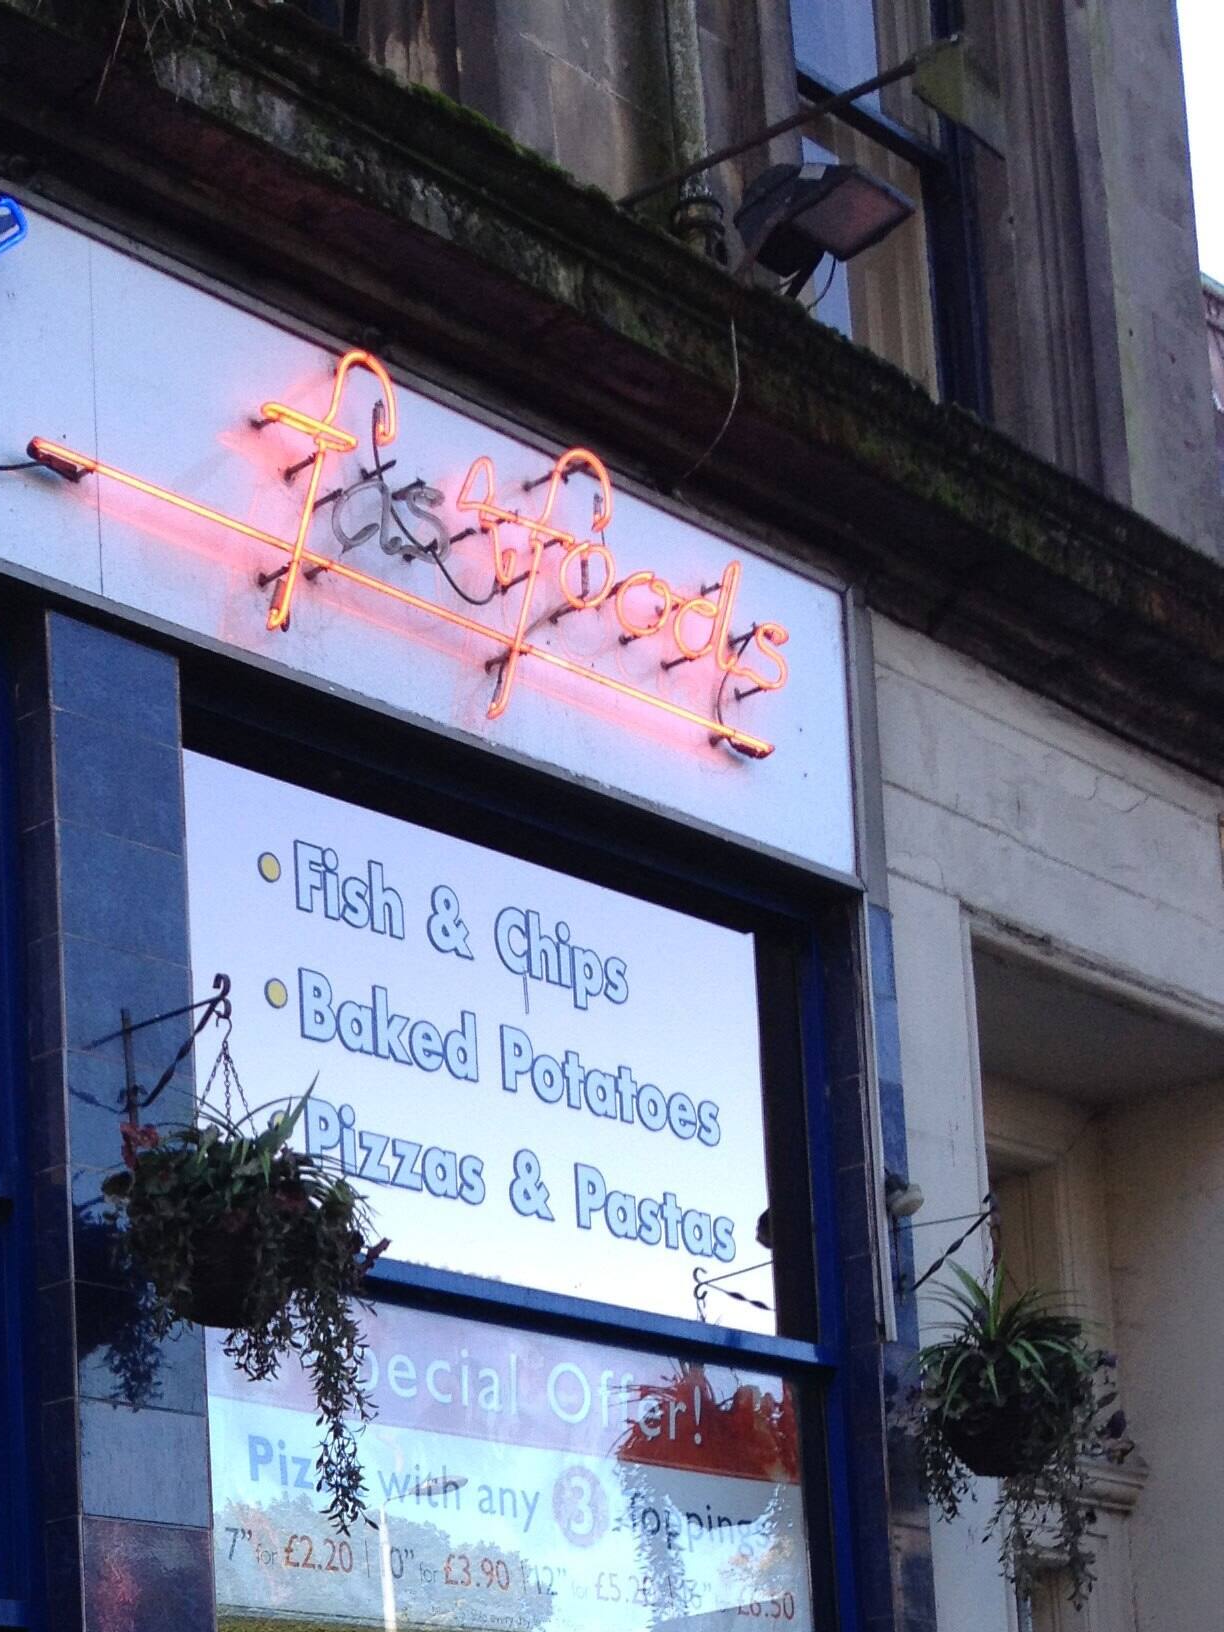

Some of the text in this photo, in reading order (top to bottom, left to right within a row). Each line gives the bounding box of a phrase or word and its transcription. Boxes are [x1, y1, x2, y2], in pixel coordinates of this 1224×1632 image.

[293, 839, 629, 1010] Fish & Chips
[298, 967, 722, 1147] Baked Potatoes
[303, 1099, 737, 1262] Pizzas & Pastas
[256, 1542, 278, 1566] for
[284, 1533, 354, 1574] £2.20
[418, 1560, 440, 1585] for
[443, 1553, 511, 1591] £3.90
[378, 1464, 461, 1511] with
[477, 1484, 540, 1533] any
[566, 1475, 595, 1537] 3
